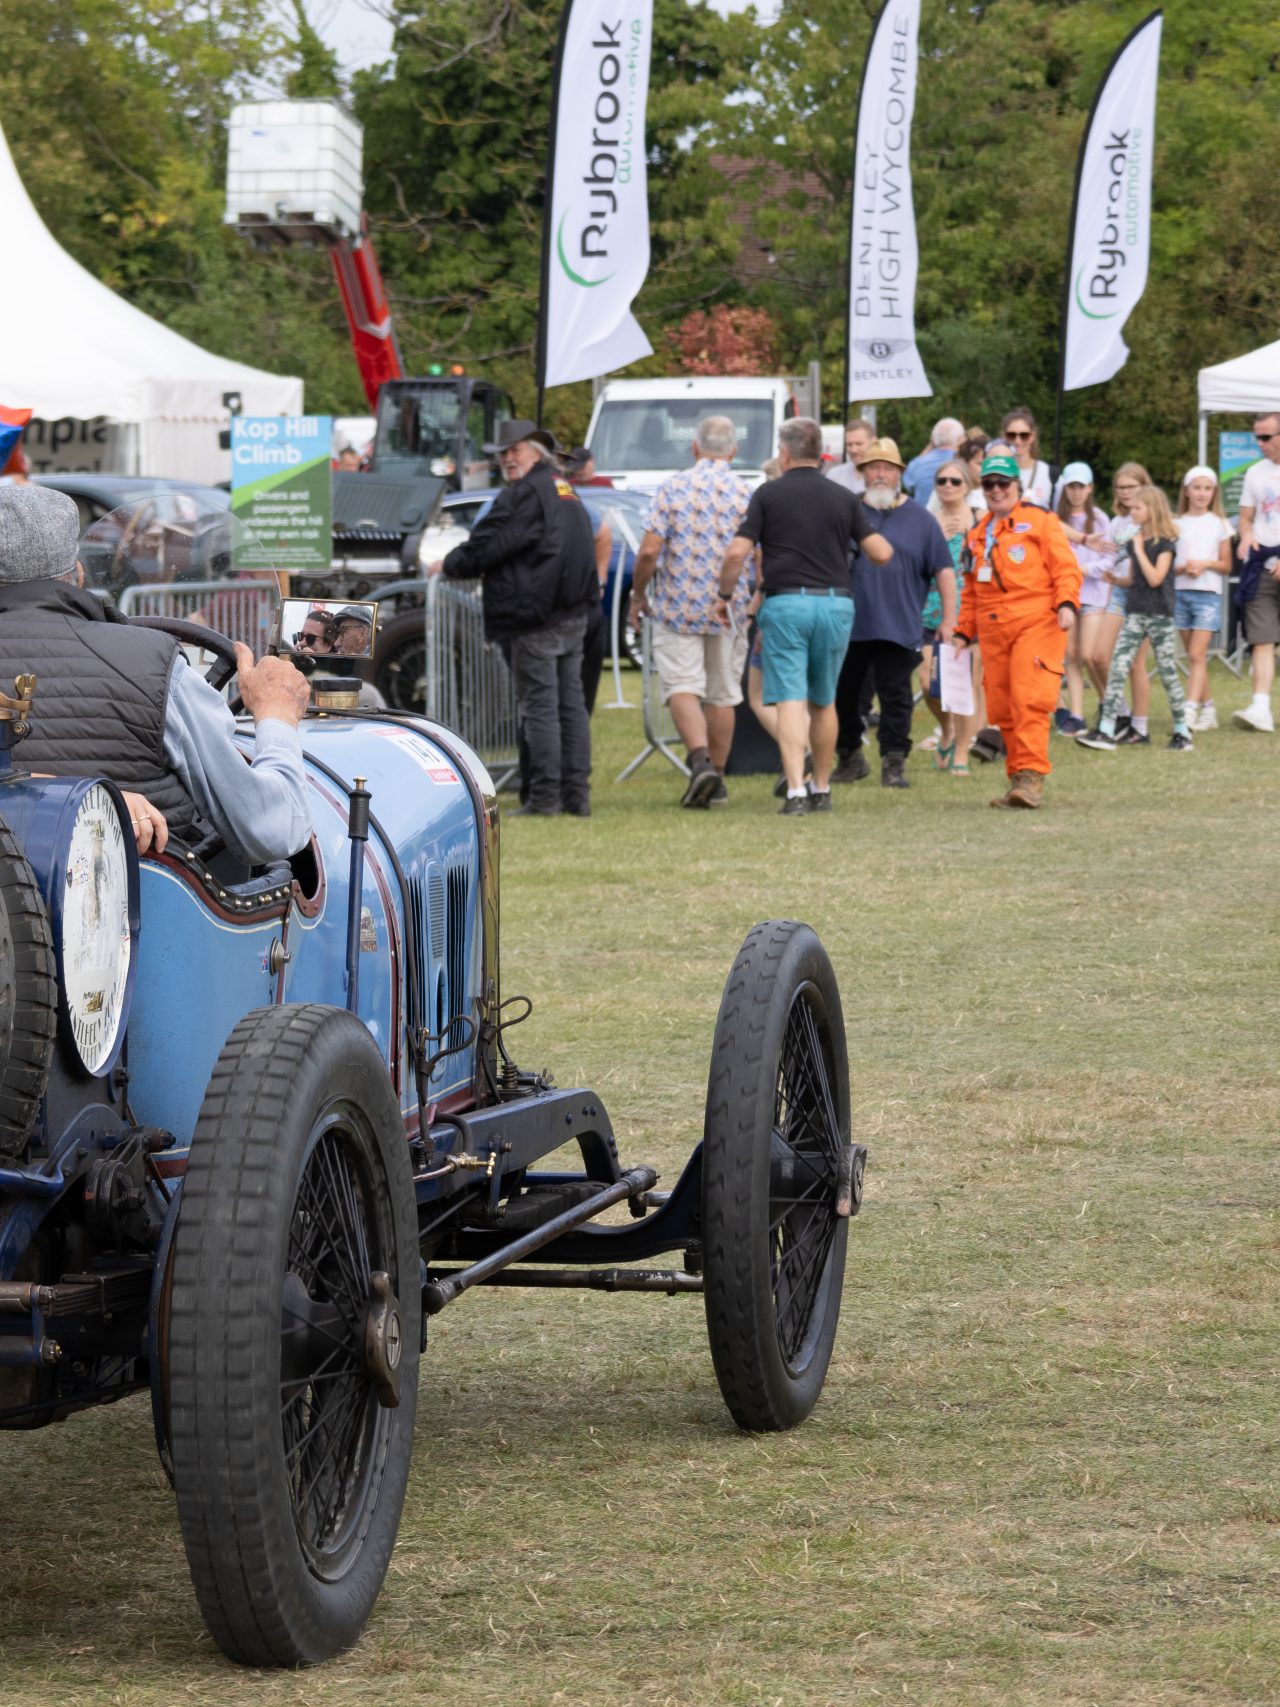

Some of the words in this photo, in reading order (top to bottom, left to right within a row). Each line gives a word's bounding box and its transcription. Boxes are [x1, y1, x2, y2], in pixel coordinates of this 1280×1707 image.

[580, 19, 623, 258] Rybrook
[617, 19, 642, 183] automotive
[881, 14, 909, 214] WYCOMBE
[854, 141, 879, 317] BENTLEY
[1089, 129, 1131, 298] Rybrook
[1125, 127, 1143, 247] automotive
[878, 229, 902, 318] HIGH
[234, 418, 279, 441] Kop
[285, 417, 318, 438] Hill
[854, 368, 913, 381] BENTLEY
[235, 444, 301, 464] Climb
